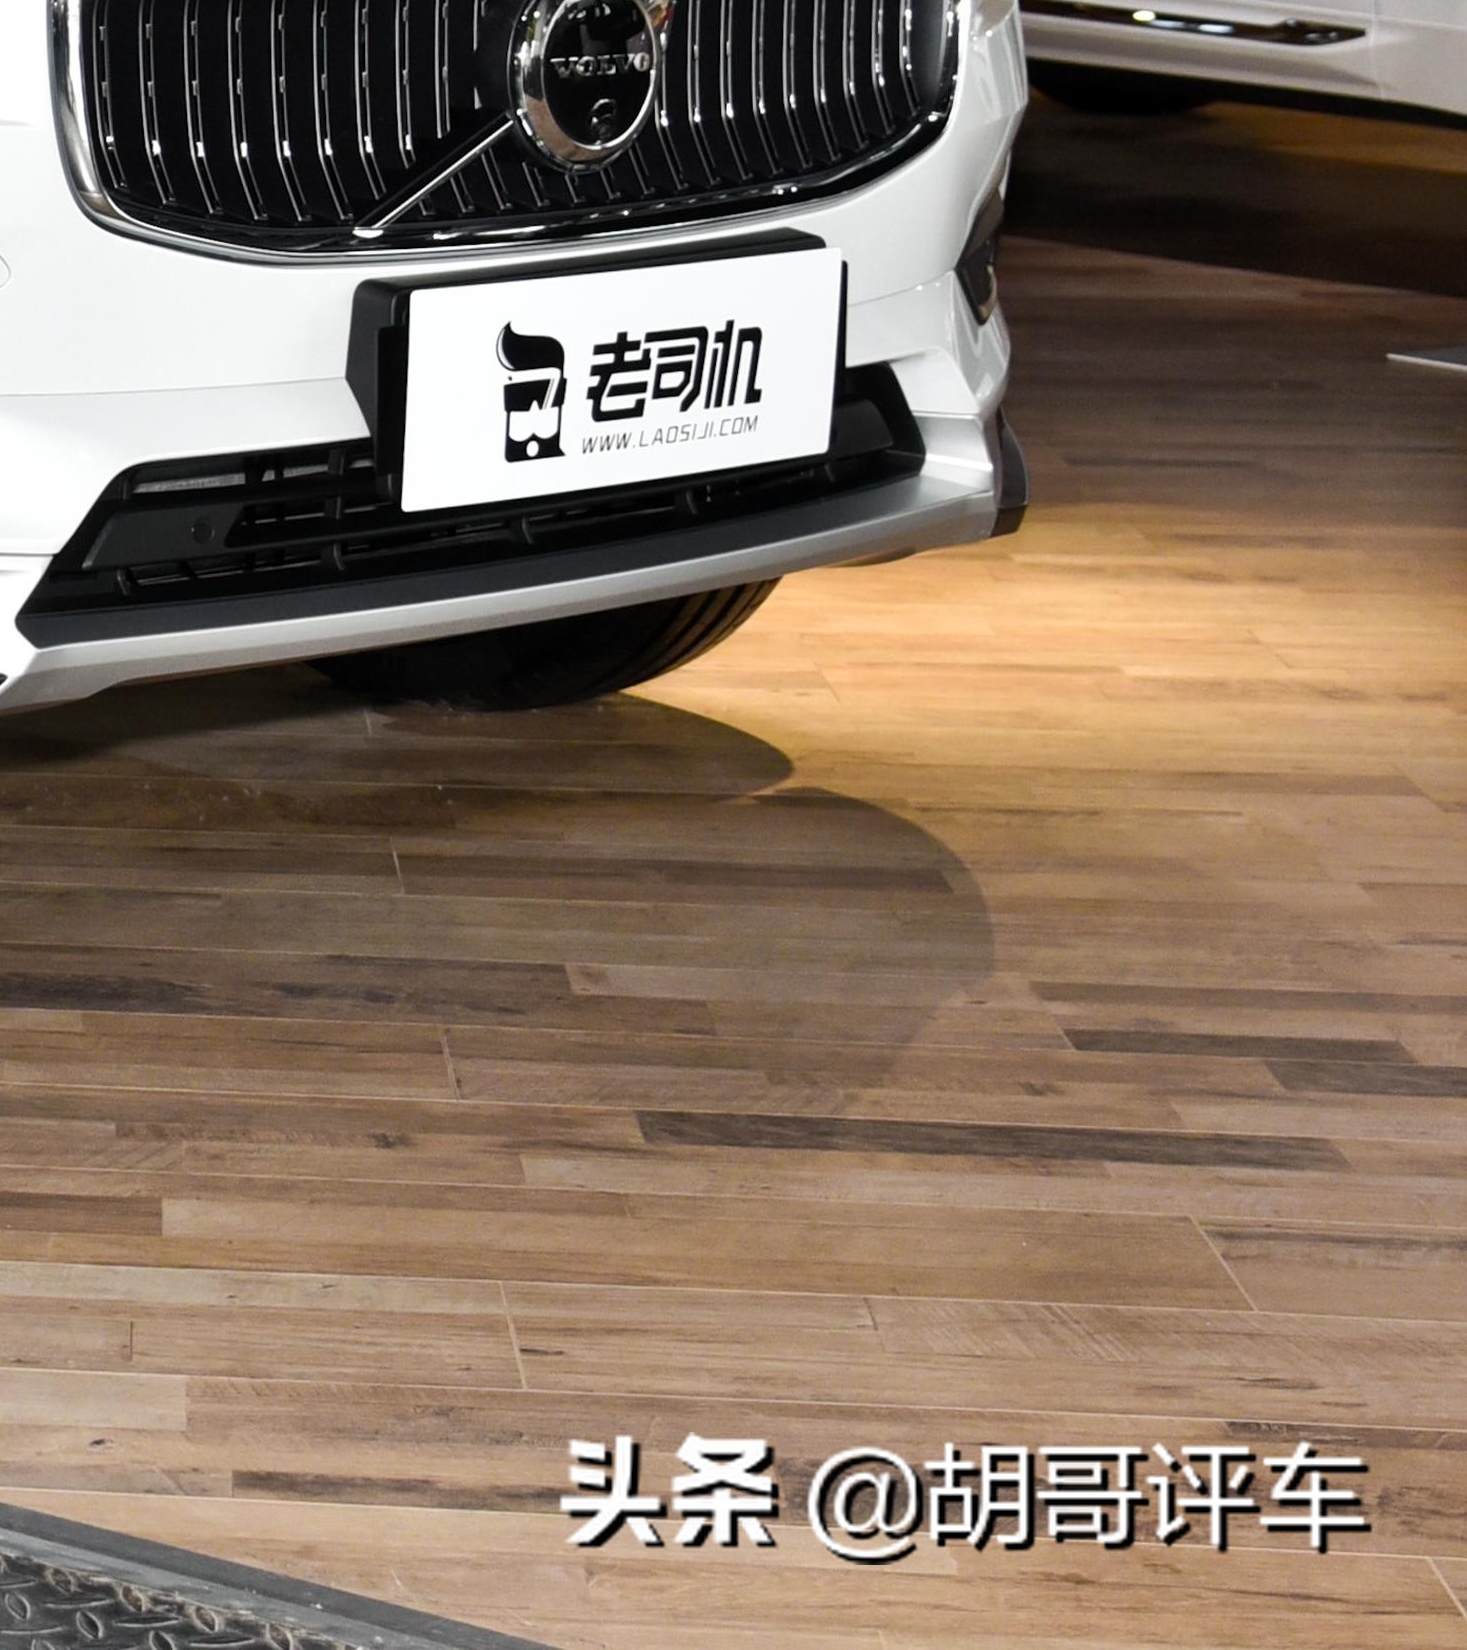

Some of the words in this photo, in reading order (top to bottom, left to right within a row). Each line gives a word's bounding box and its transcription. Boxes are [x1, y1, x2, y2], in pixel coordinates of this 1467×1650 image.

[550, 52, 651, 79] VOLVO
[584, 319, 764, 423] 老司机
[580, 415, 759, 455] WWW.LAOSIJI.COM
